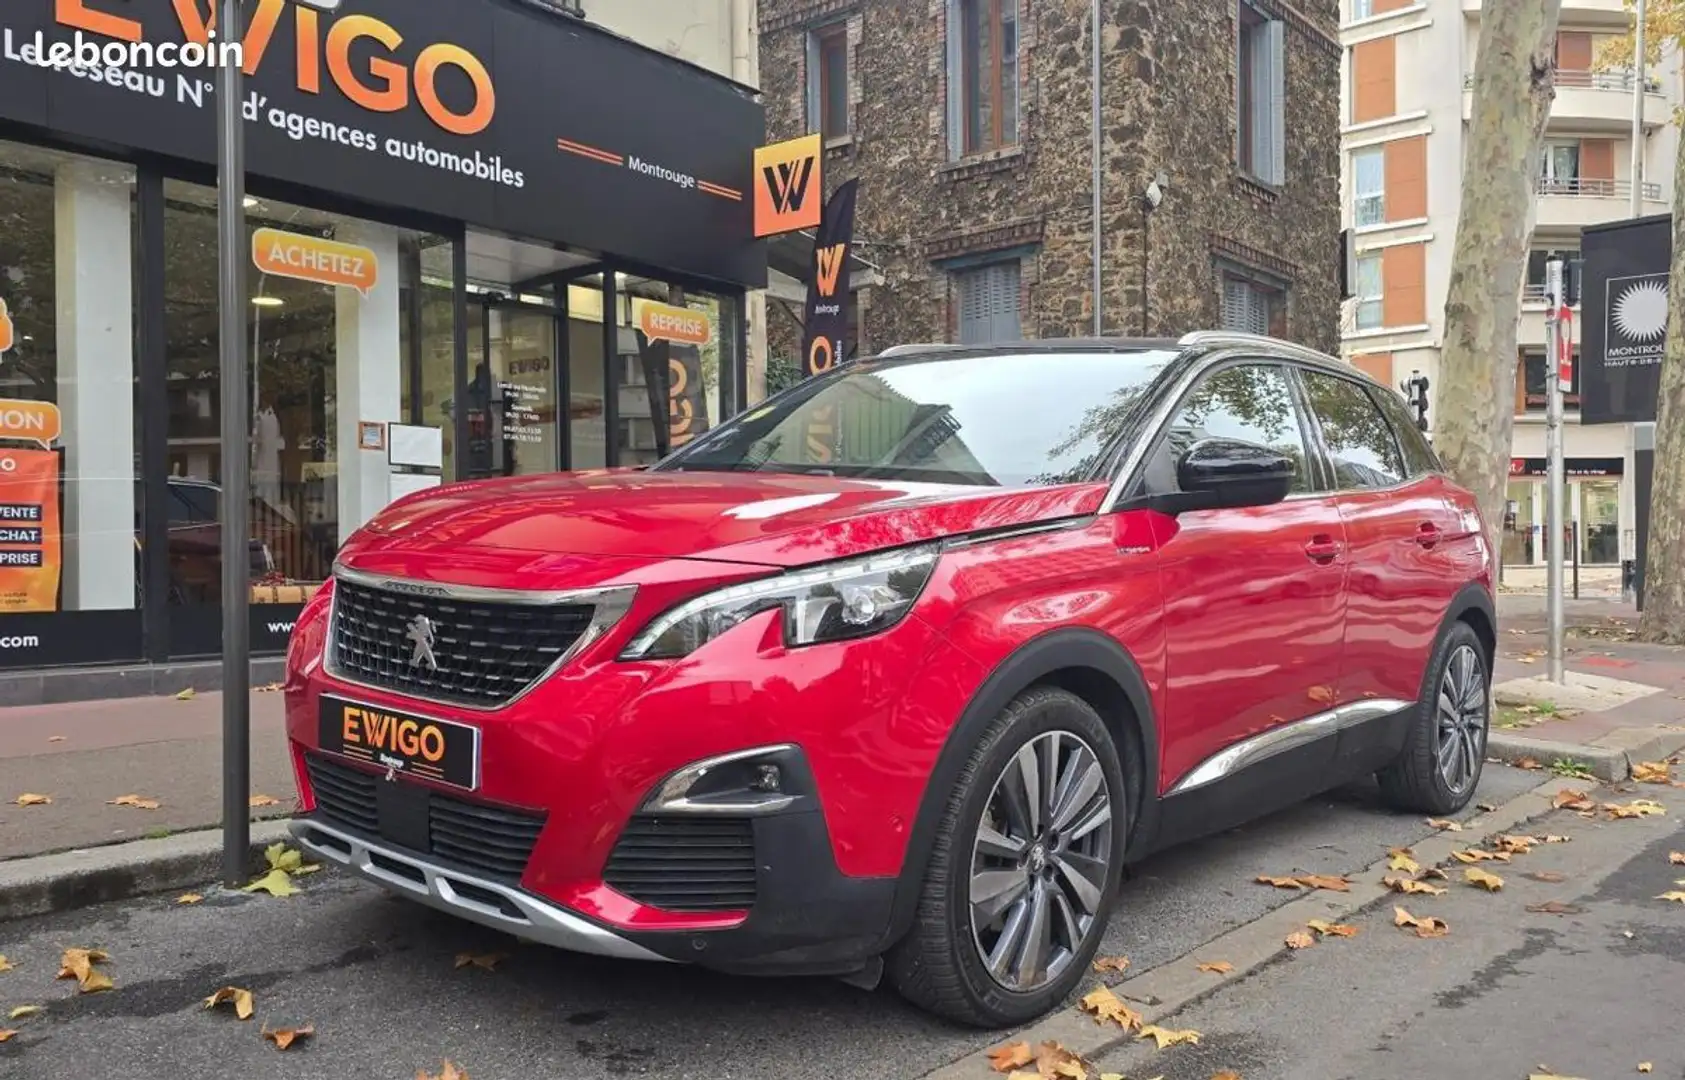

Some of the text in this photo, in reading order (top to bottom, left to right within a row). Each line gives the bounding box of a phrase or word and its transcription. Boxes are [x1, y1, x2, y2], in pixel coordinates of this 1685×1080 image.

[53, 56, 165, 97] éseau
[242, 92, 377, 152] d'agences
[385, 136, 525, 189] automobiles
[627, 156, 695, 188] Montrouge
[763, 156, 814, 215] W
[268, 242, 366, 278] ACHETEZ
[650, 312, 702, 336] REPRISE
[343, 706, 445, 762] EWIGO
